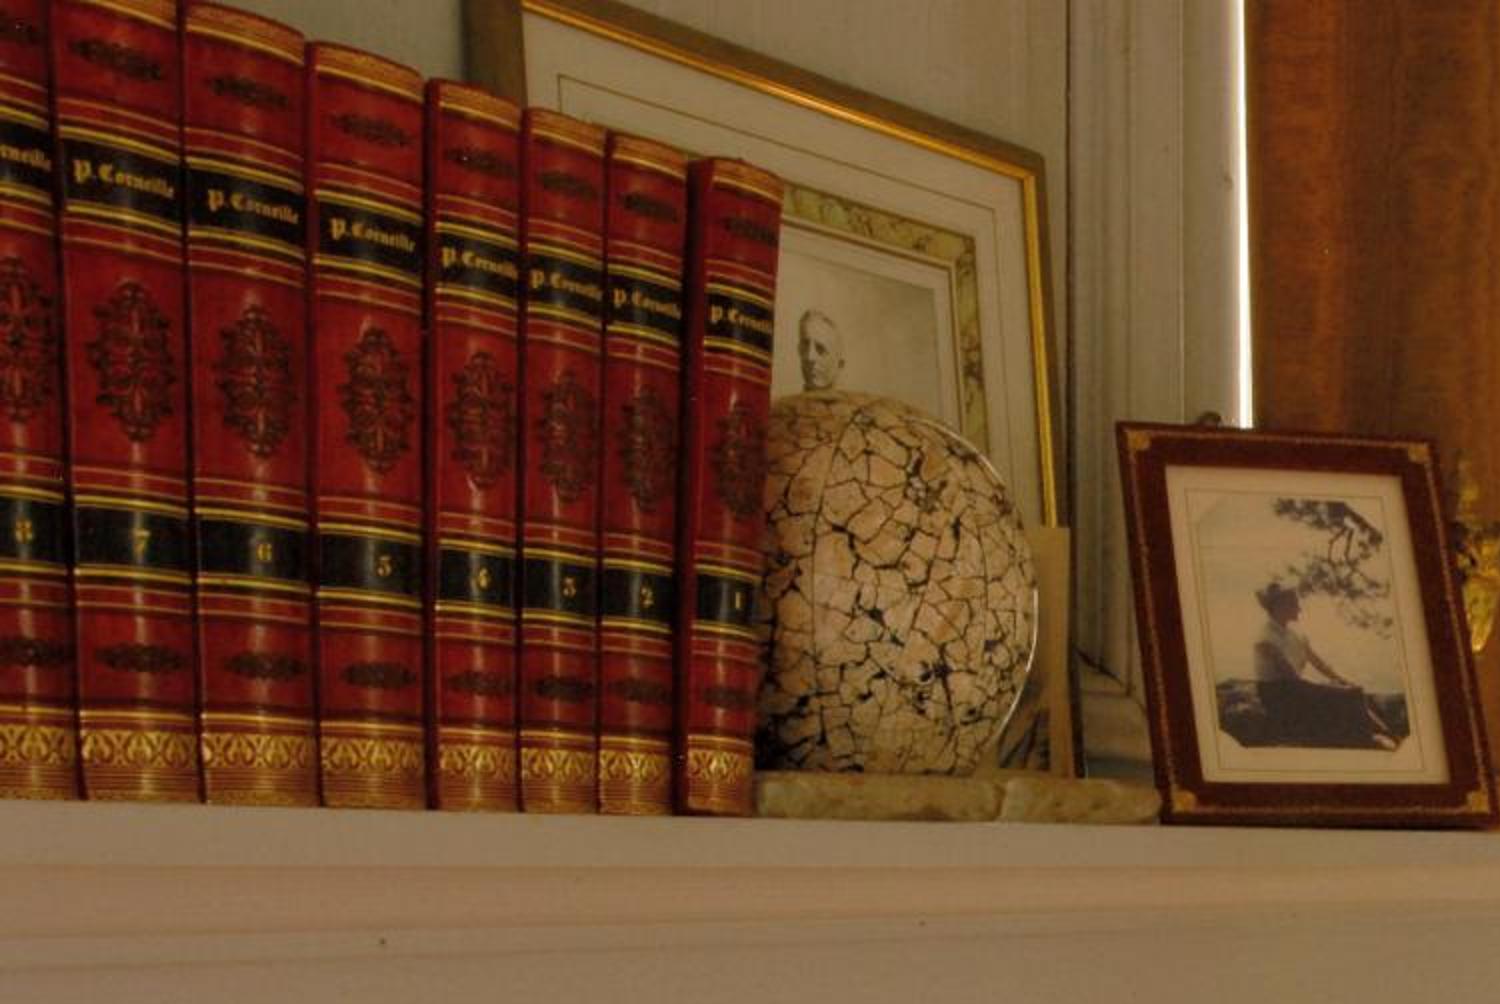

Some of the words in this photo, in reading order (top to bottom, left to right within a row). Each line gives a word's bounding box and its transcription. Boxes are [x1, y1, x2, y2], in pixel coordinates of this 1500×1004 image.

[132, 528, 151, 556] 7
[256, 541, 274, 563] 6
[377, 555, 393, 578] 5
[640, 585, 654, 609] 2
[735, 591, 741, 611] 1
